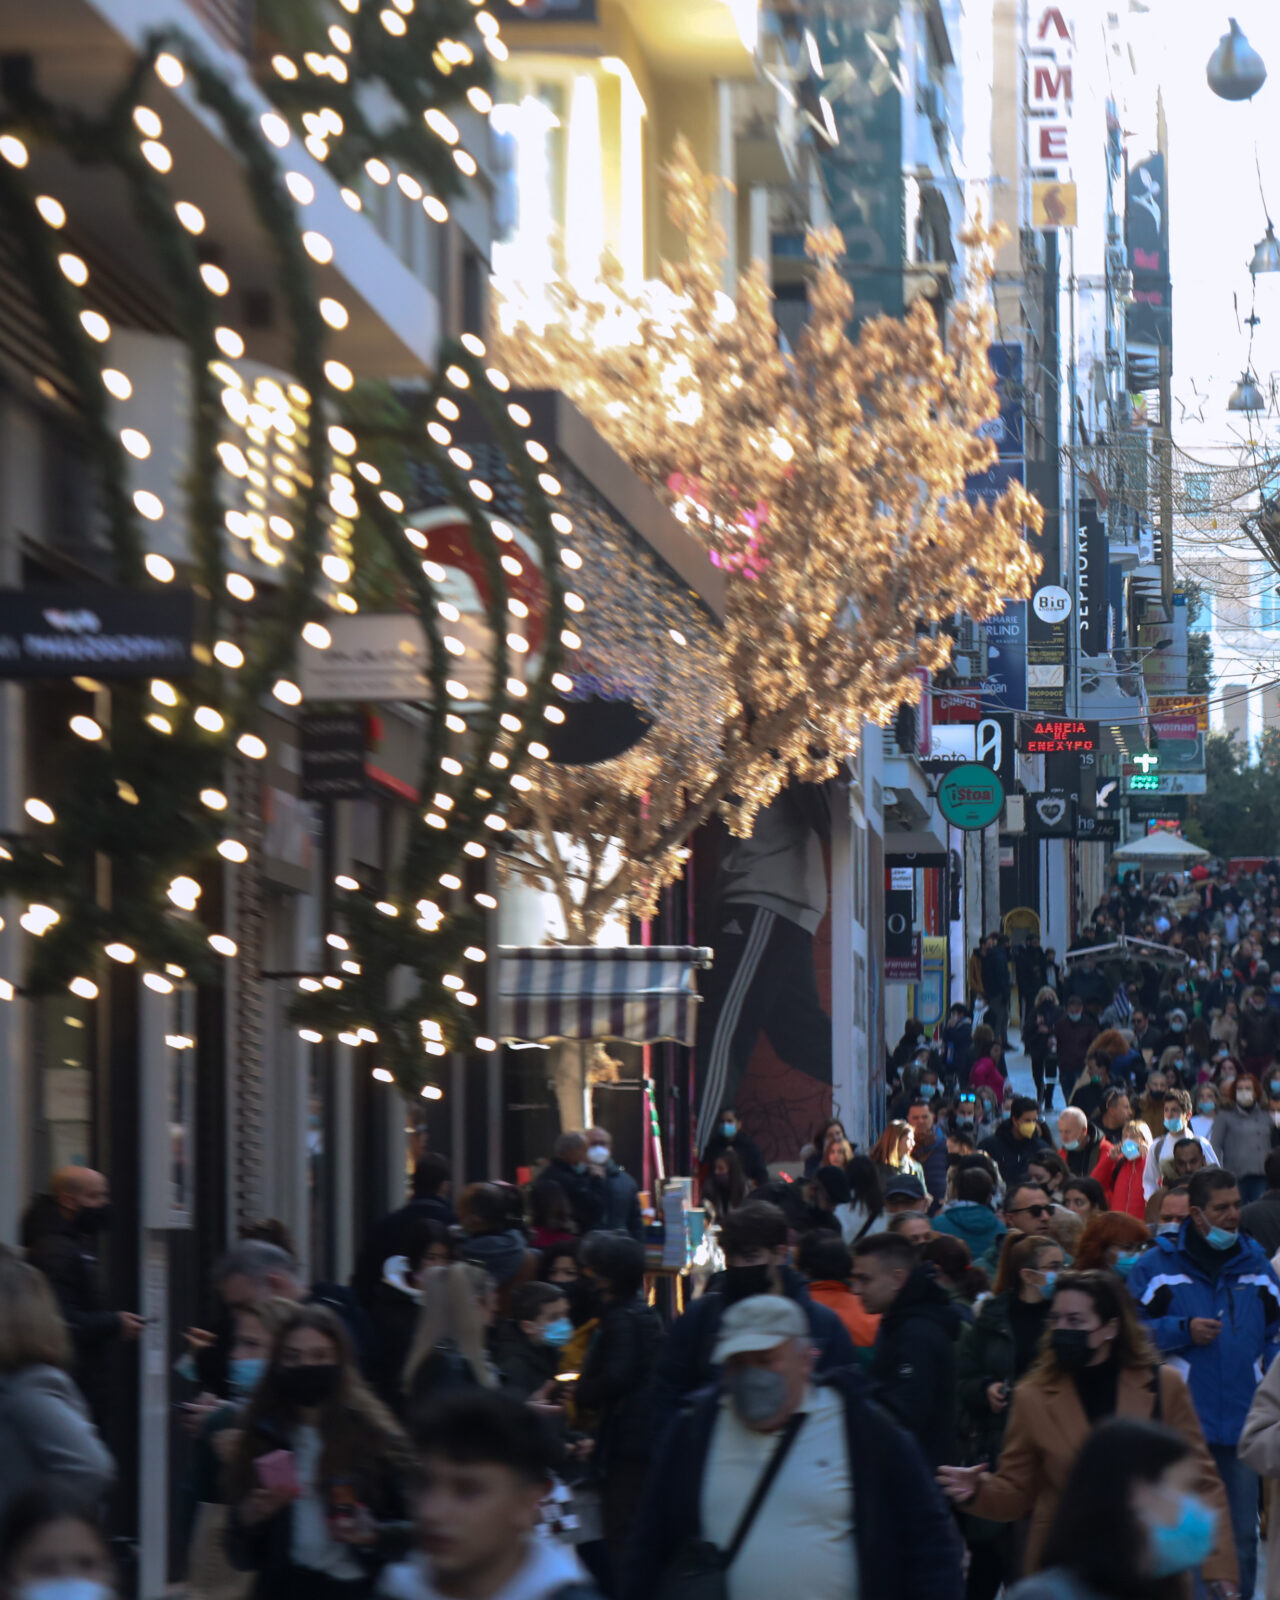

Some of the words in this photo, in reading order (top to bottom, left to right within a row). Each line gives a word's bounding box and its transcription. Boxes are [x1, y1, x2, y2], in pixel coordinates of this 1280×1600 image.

[1078, 525, 1089, 630] SEPHORA
[1038, 596, 1065, 610] Big
[1156, 697, 1200, 707] ΑΓΟΡΑ
[1034, 722, 1087, 734] ΔΑΝΕΙΑ
[1027, 740, 1094, 752] ΕΝΕΧΥΡΟ
[951, 788, 991, 801] iStoa
